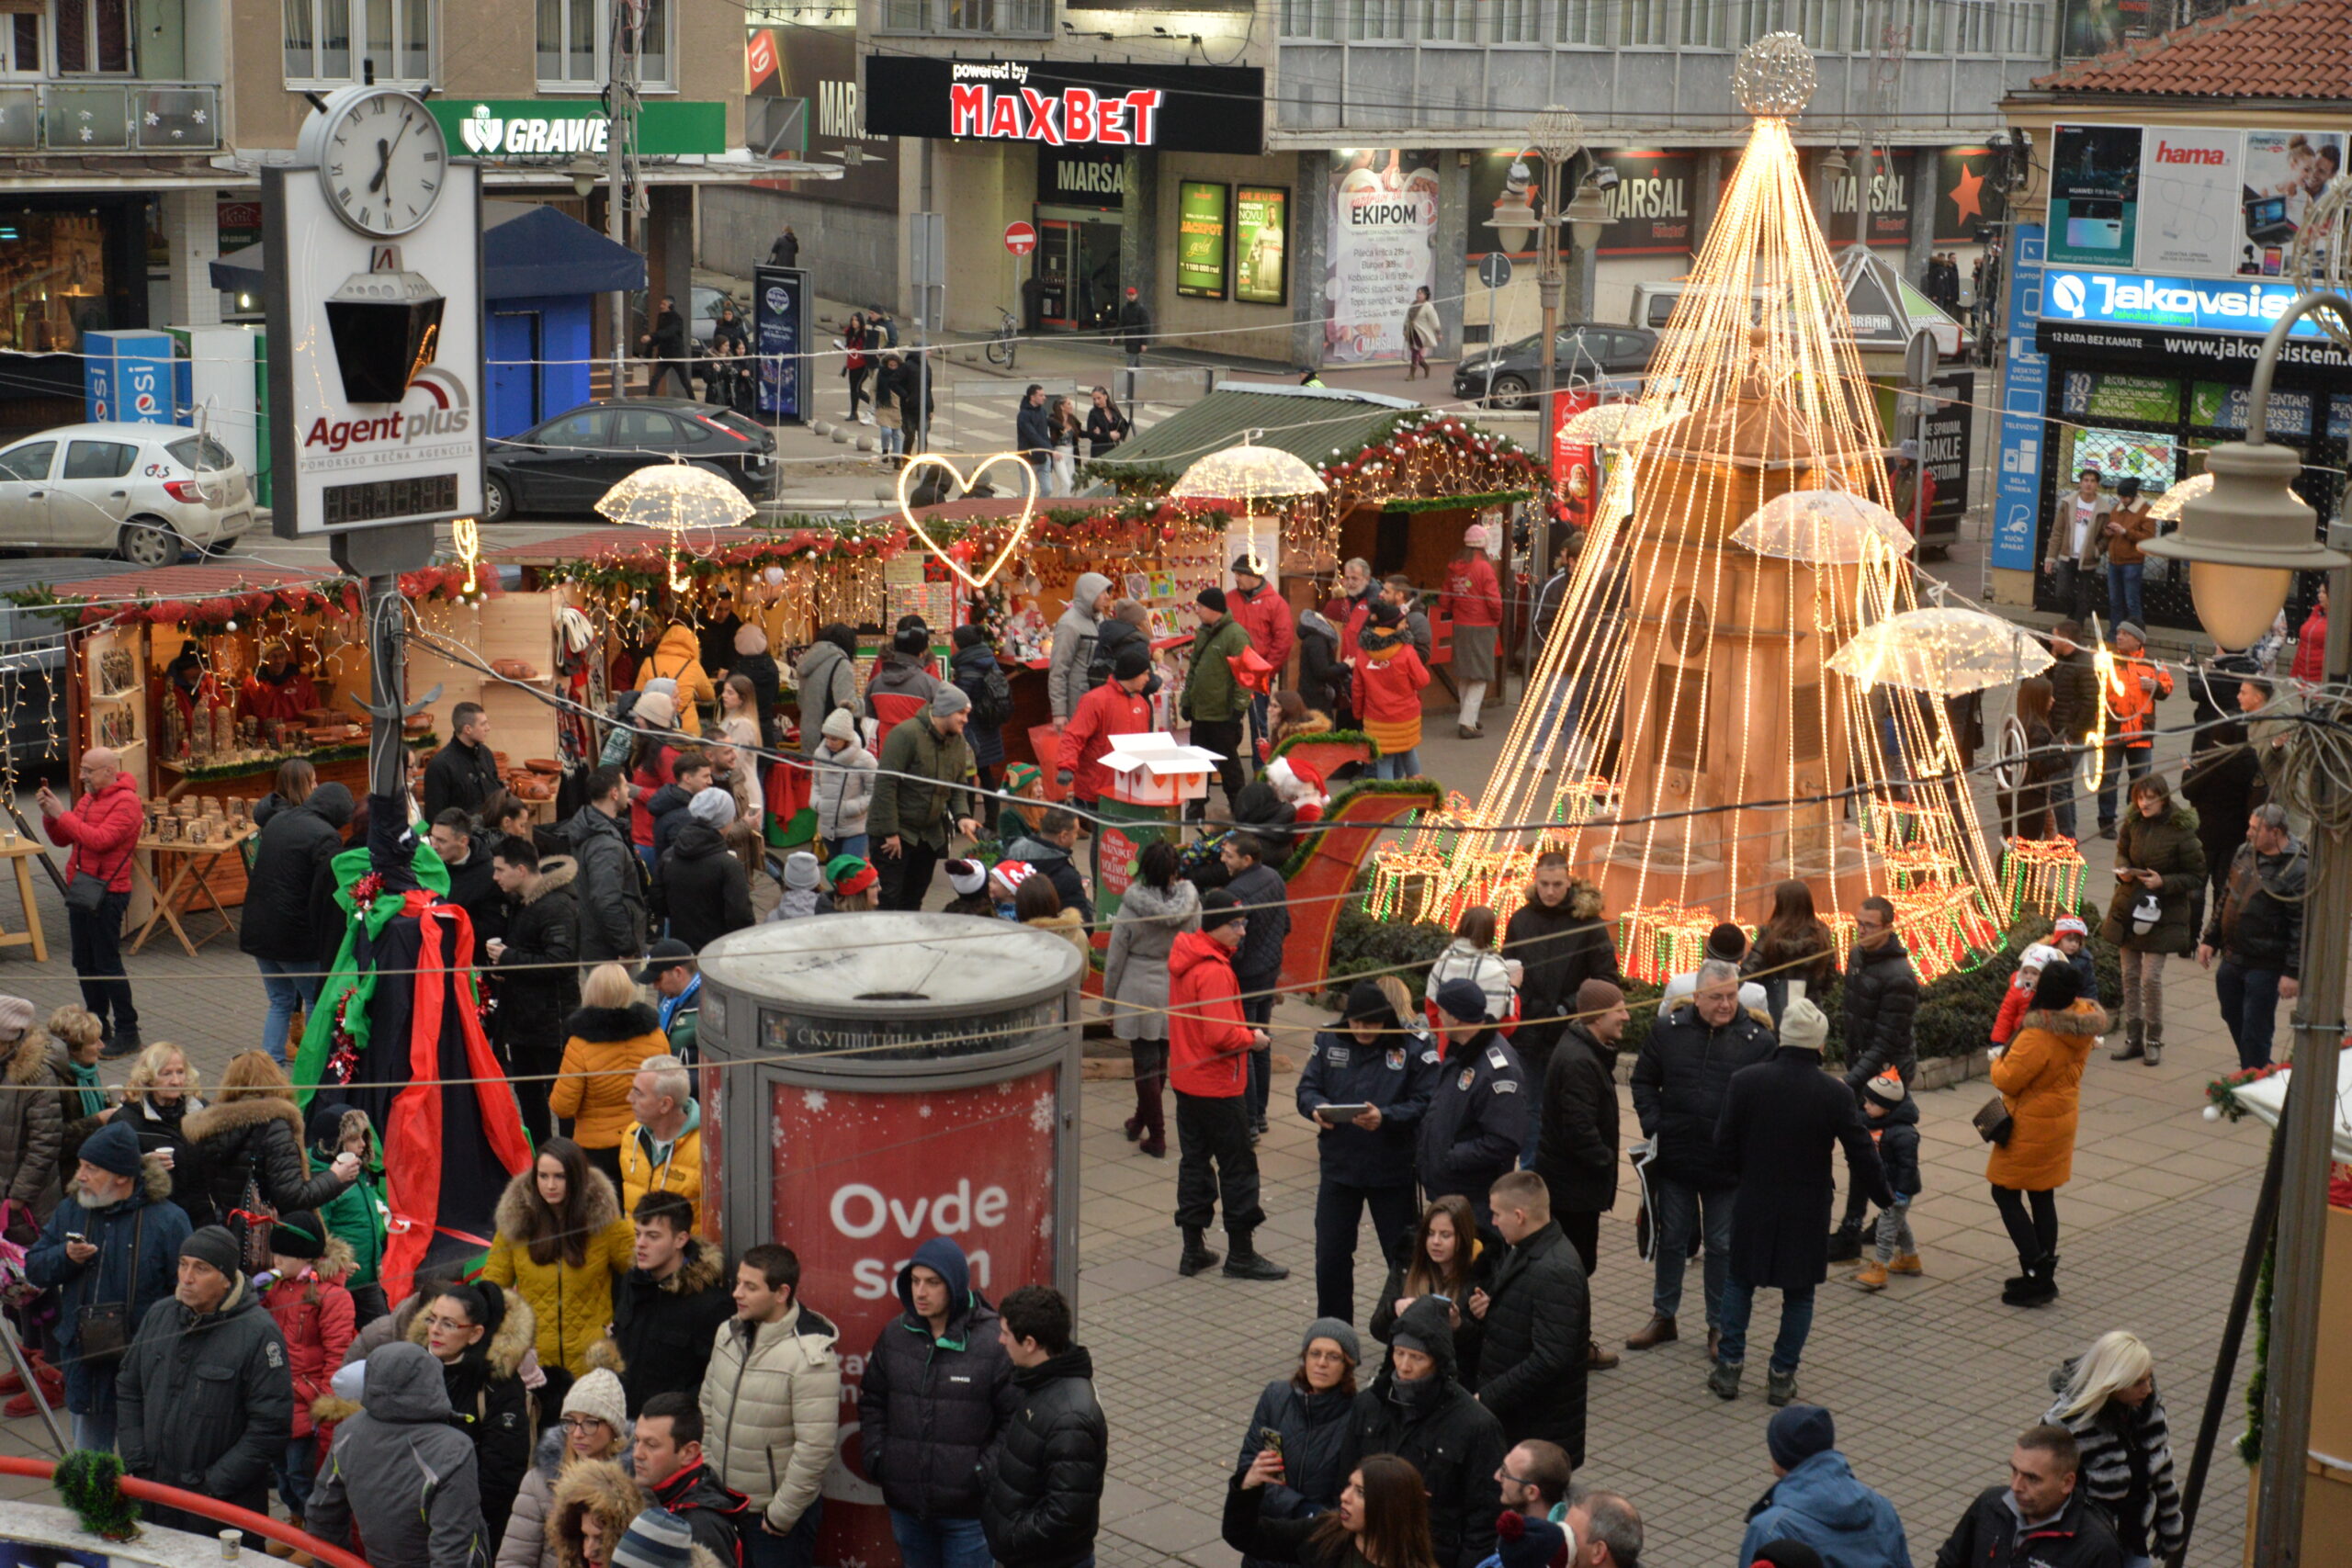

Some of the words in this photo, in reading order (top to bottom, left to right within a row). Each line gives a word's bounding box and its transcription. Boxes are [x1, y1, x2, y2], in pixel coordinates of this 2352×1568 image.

[953, 62, 1010, 81] powered
[1012, 62, 1029, 84] by
[820, 80, 889, 141] MAR
[505, 118, 612, 153] GRAWE
[2155, 141, 2225, 165] hama
[1057, 160, 1125, 194] MARSA
[1238, 210, 1263, 220] NOVU
[1351, 204, 1417, 225] EKIPOM
[2017, 321, 2037, 330] TABLE
[2052, 332, 2062, 343] 12
[2064, 333, 2085, 344] RATA
[2087, 333, 2104, 345] BEZ
[2106, 335, 2143, 348] KAMATE
[2164, 337, 2352, 367] www.jakosistem.
[2012, 367, 2041, 376] DESKTOP
[2069, 373, 2091, 393] 10
[2069, 395, 2086, 412] 12
[305, 411, 403, 452] Agent
[404, 406, 469, 445] plus
[2005, 421, 2039, 431] TELEVIZOR
[300, 456, 366, 470] POMORSKO
[374, 450, 411, 463] REČNA
[419, 445, 474, 458] AGENCIJA
[1924, 436, 1962, 462] DAKLE
[145, 464, 170, 479] G4S
[1928, 463, 1961, 481] OSTOJIM
[2009, 477, 2027, 485] BELA
[797, 1028, 928, 1051] СКУПШТИНА
[932, 1026, 993, 1051] ГРАДА
[830, 1178, 1009, 1238] Ovde
